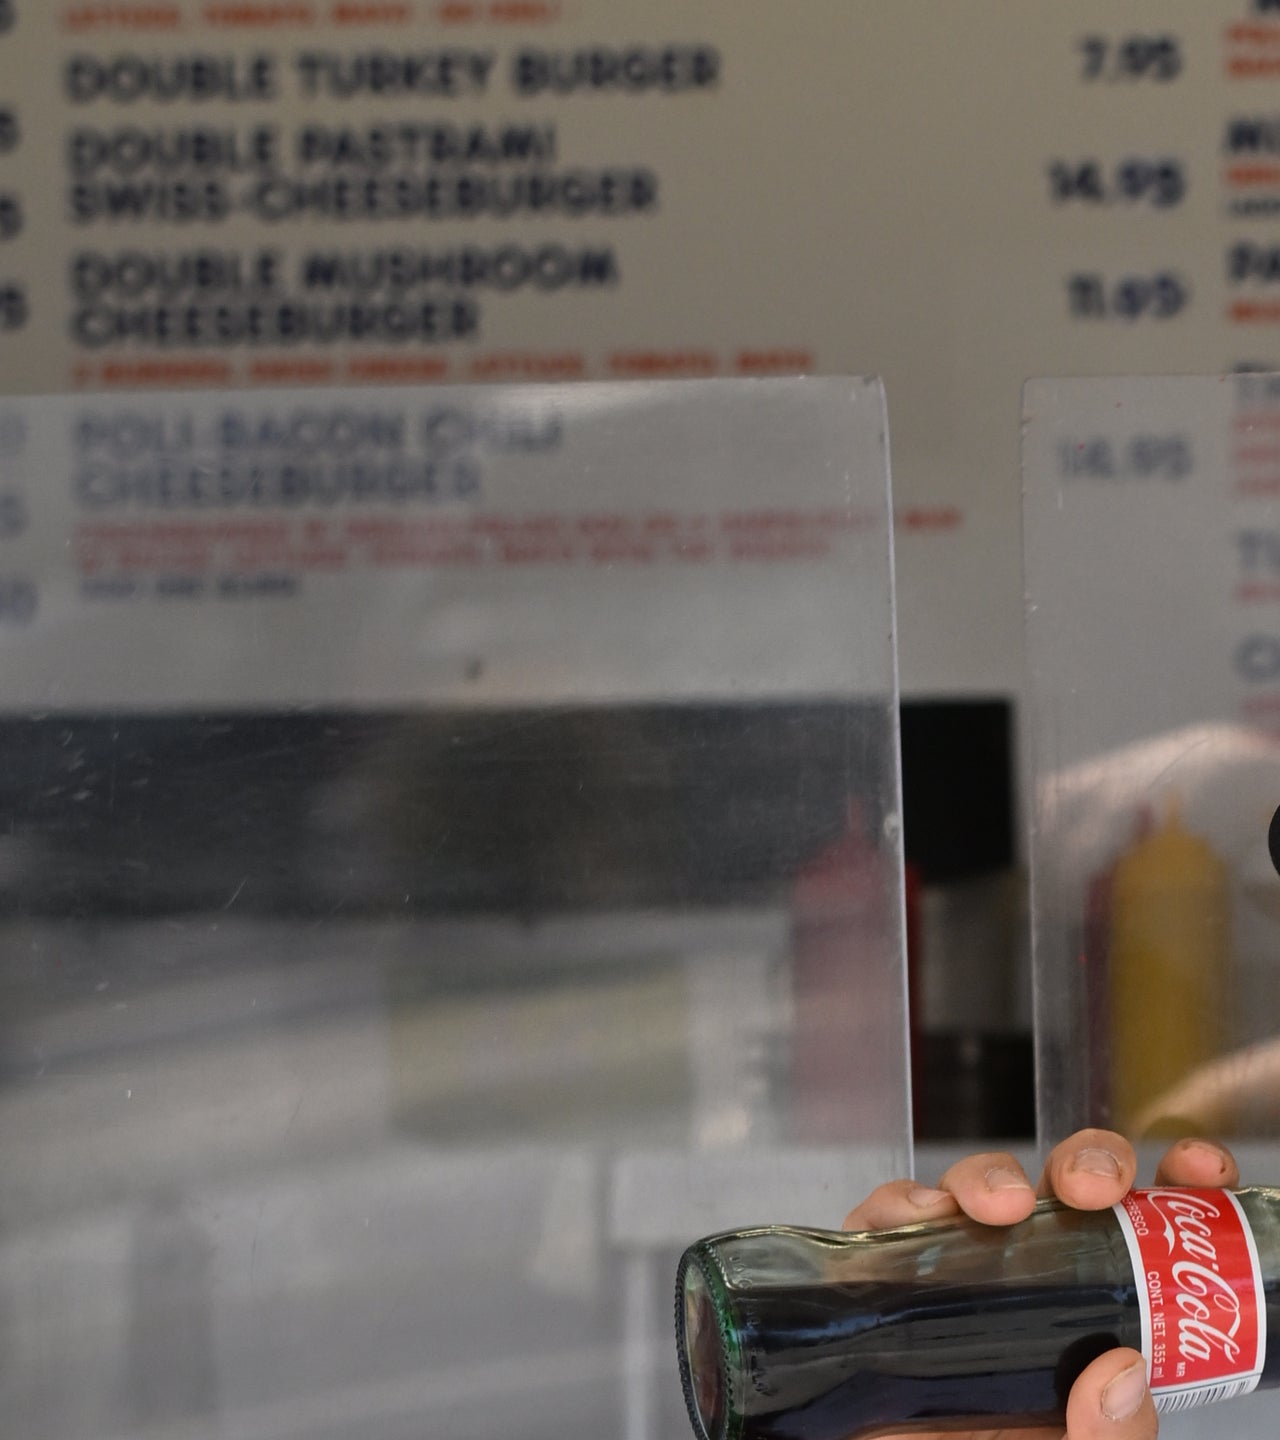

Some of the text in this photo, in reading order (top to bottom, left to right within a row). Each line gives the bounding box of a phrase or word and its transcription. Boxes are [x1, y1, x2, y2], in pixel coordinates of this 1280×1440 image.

[63, 47, 719, 103] DOUBLE TURKEY BURGER
[68, 125, 279, 179] DOUBLE
[298, 124, 554, 173] PASTRAMI
[71, 246, 617, 299] DOUBLE MUSHROOM
[69, 295, 478, 348] CHEESEBURGER
[214, 409, 405, 459] BACON
[76, 455, 479, 510] CHEESEBURGER
[1147, 1271, 1166, 1379] CONT. NET. 355 ml
